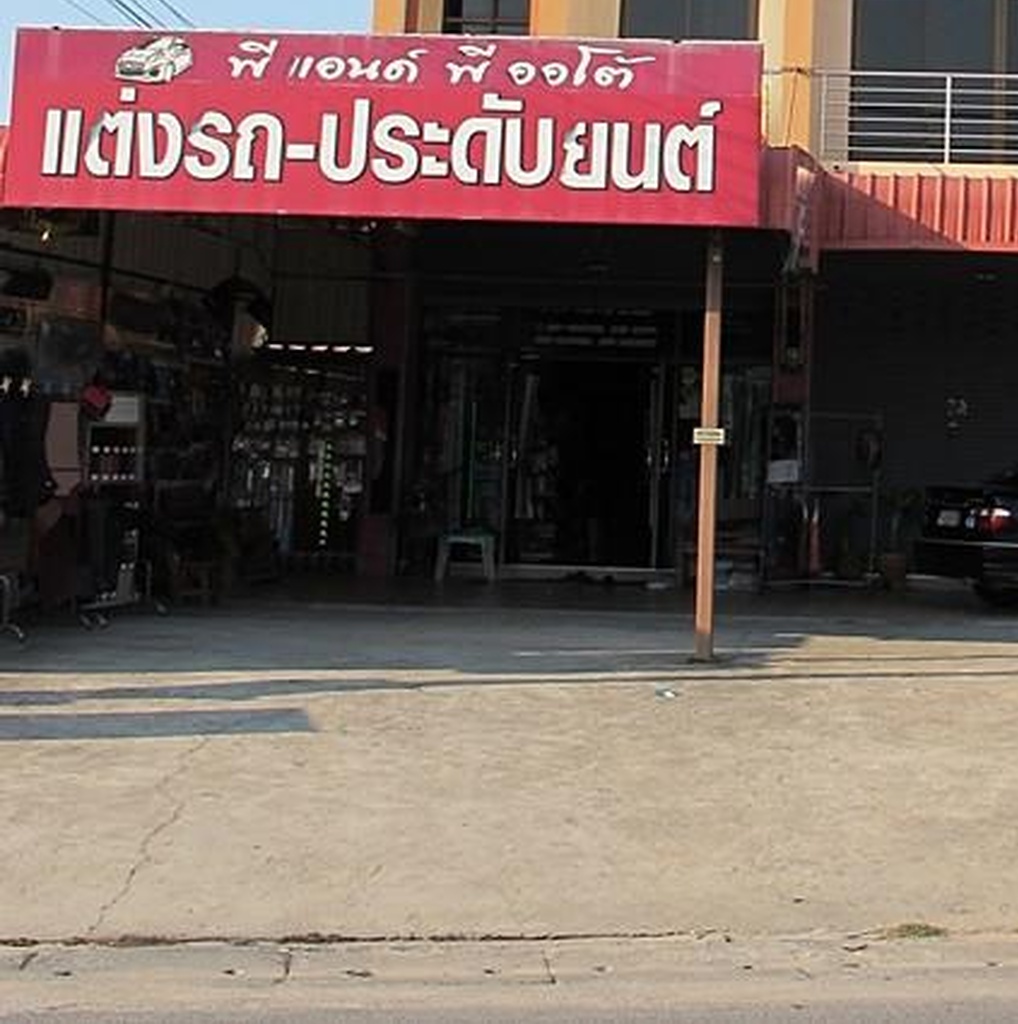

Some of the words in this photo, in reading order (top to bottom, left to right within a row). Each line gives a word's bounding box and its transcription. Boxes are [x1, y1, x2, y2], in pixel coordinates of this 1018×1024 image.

[228, 39, 278, 78] พี
[288, 48, 429, 84] แอนด์
[446, 43, 497, 84] พี
[40, 87, 722, 192] แต่งรถ-ประดับยนต์
